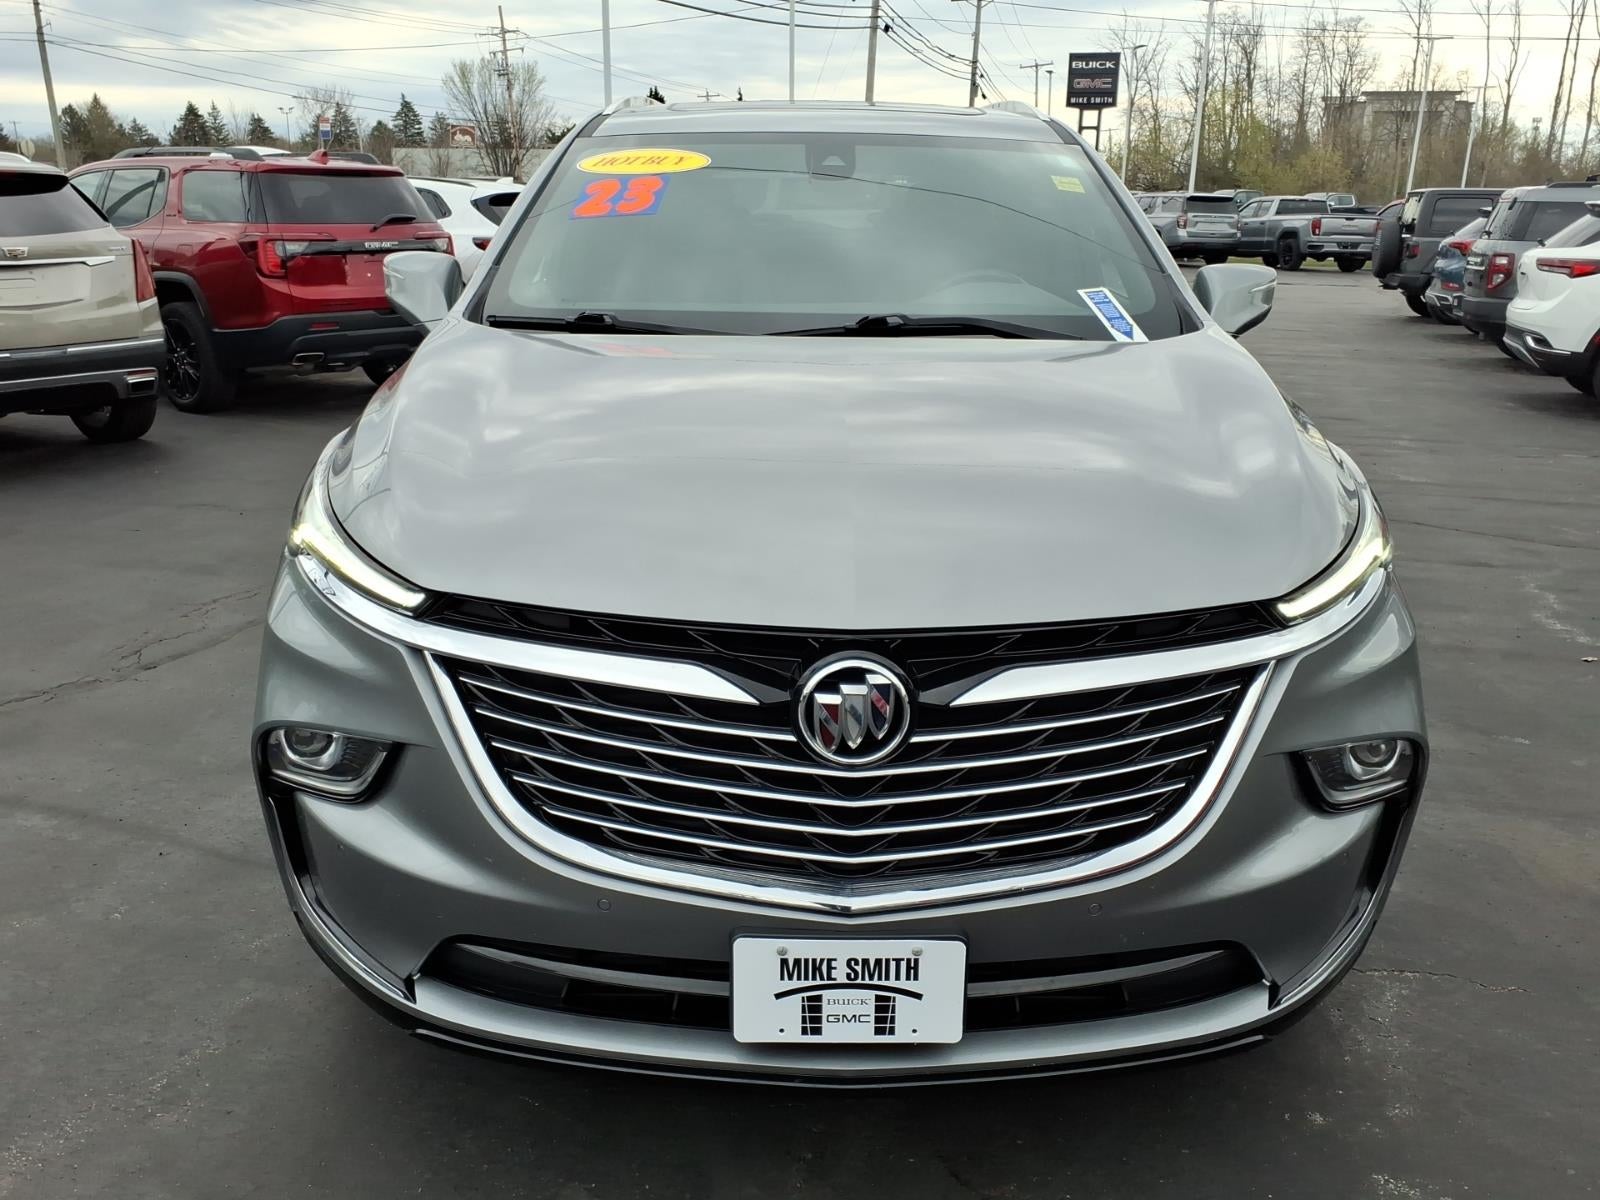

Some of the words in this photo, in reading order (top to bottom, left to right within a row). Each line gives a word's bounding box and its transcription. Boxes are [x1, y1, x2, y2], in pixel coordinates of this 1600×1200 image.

[1071, 60, 1116, 69] BUICK
[1073, 78, 1113, 88] GMC
[573, 175, 664, 217] 23
[779, 957, 838, 981] MIKE
[845, 957, 919, 982] SMITH
[826, 998, 870, 1006] BUICK
[826, 1014, 871, 1023] GMC
